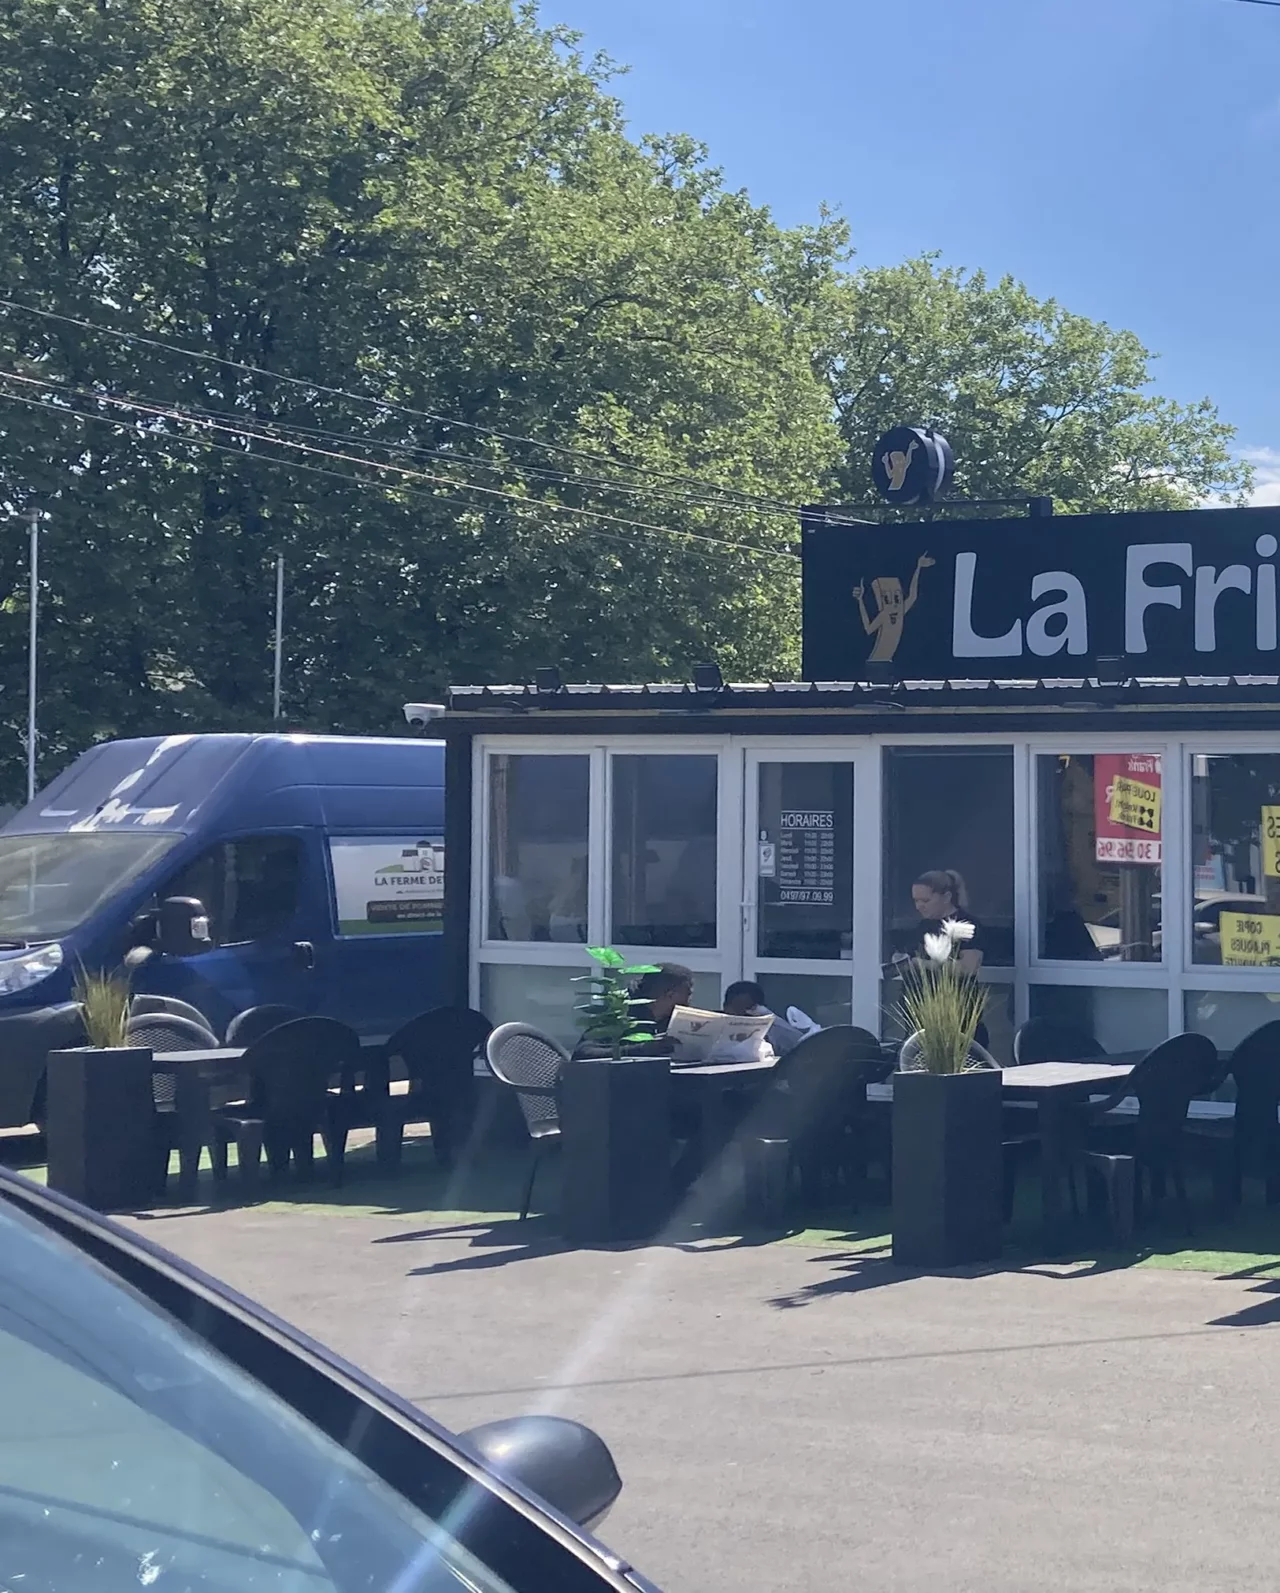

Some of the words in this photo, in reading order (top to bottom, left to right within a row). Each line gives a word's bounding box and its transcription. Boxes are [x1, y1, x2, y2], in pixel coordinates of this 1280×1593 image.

[952, 551, 1088, 658] La
[780, 814, 833, 828] HORAIRES
[374, 877, 387, 886] LA
[390, 876, 426, 886] FERME
